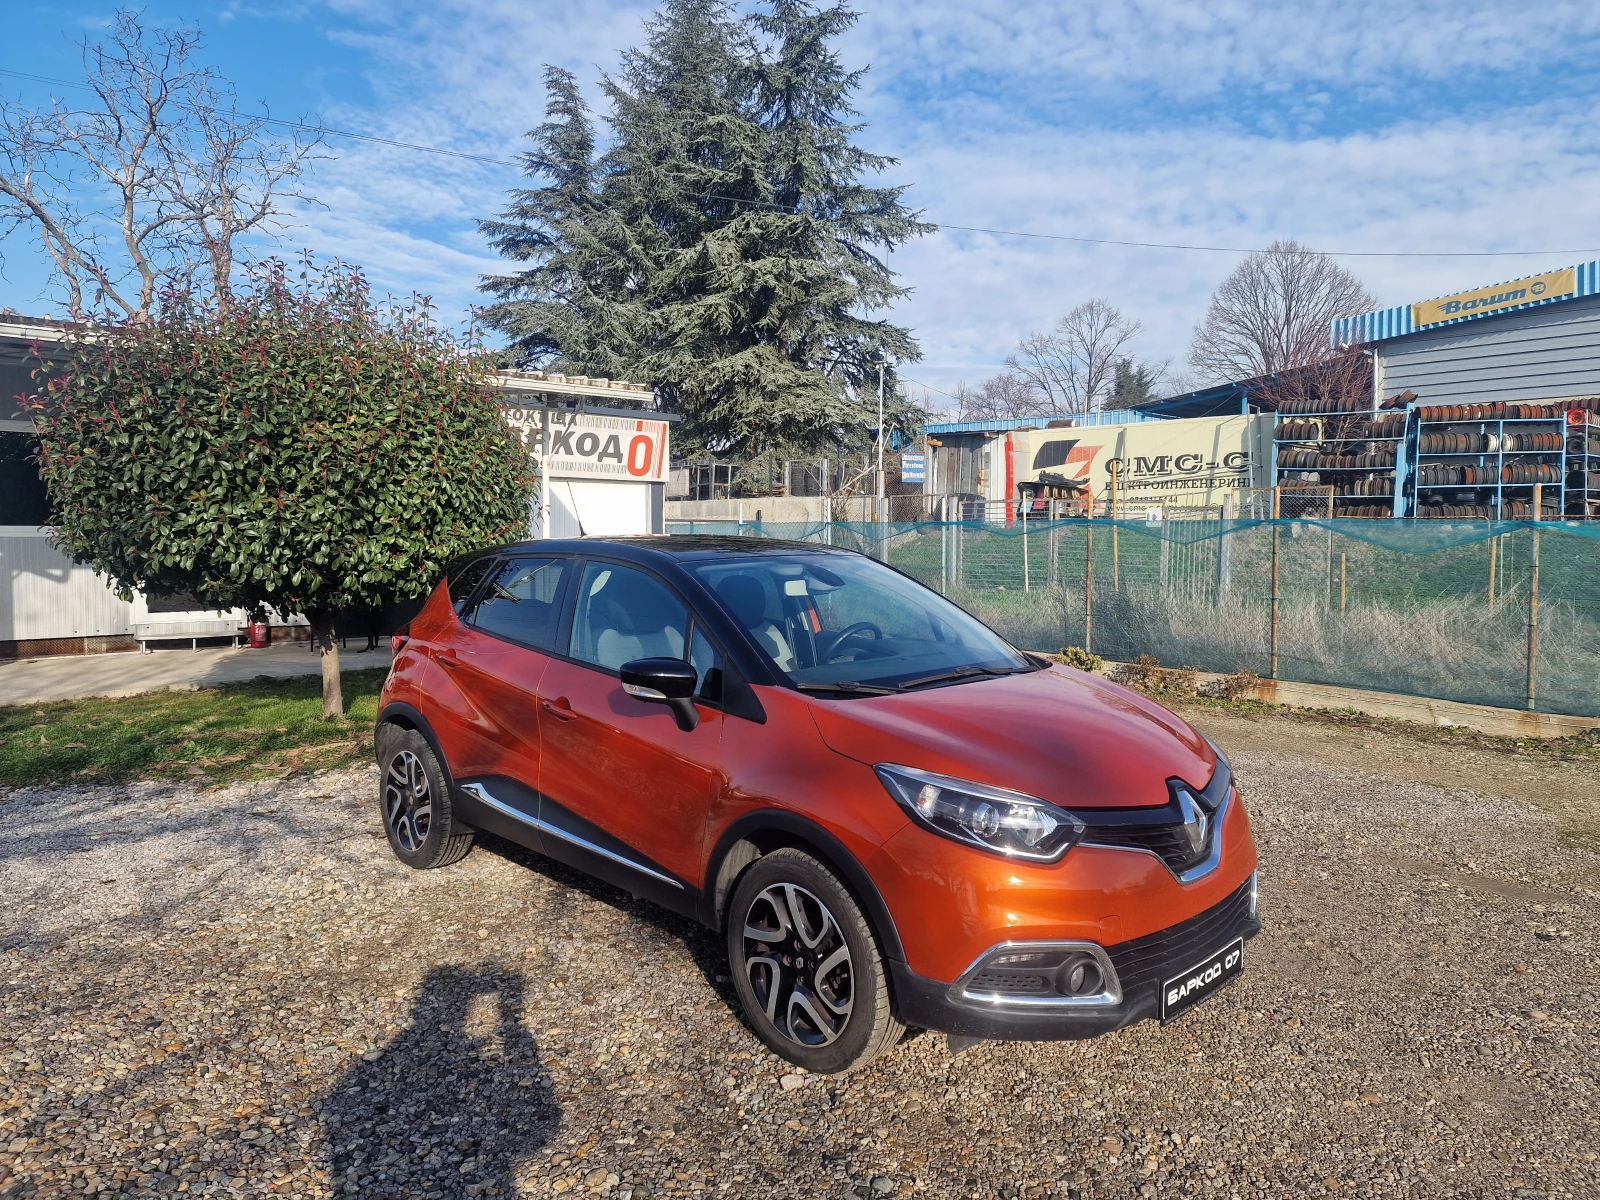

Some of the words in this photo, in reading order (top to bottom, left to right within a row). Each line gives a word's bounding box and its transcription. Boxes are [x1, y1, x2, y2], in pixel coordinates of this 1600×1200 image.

[1437, 287, 1526, 315] Barum
[1168, 963, 1222, 1006] БАРКОД
[1225, 950, 1240, 969] 07
